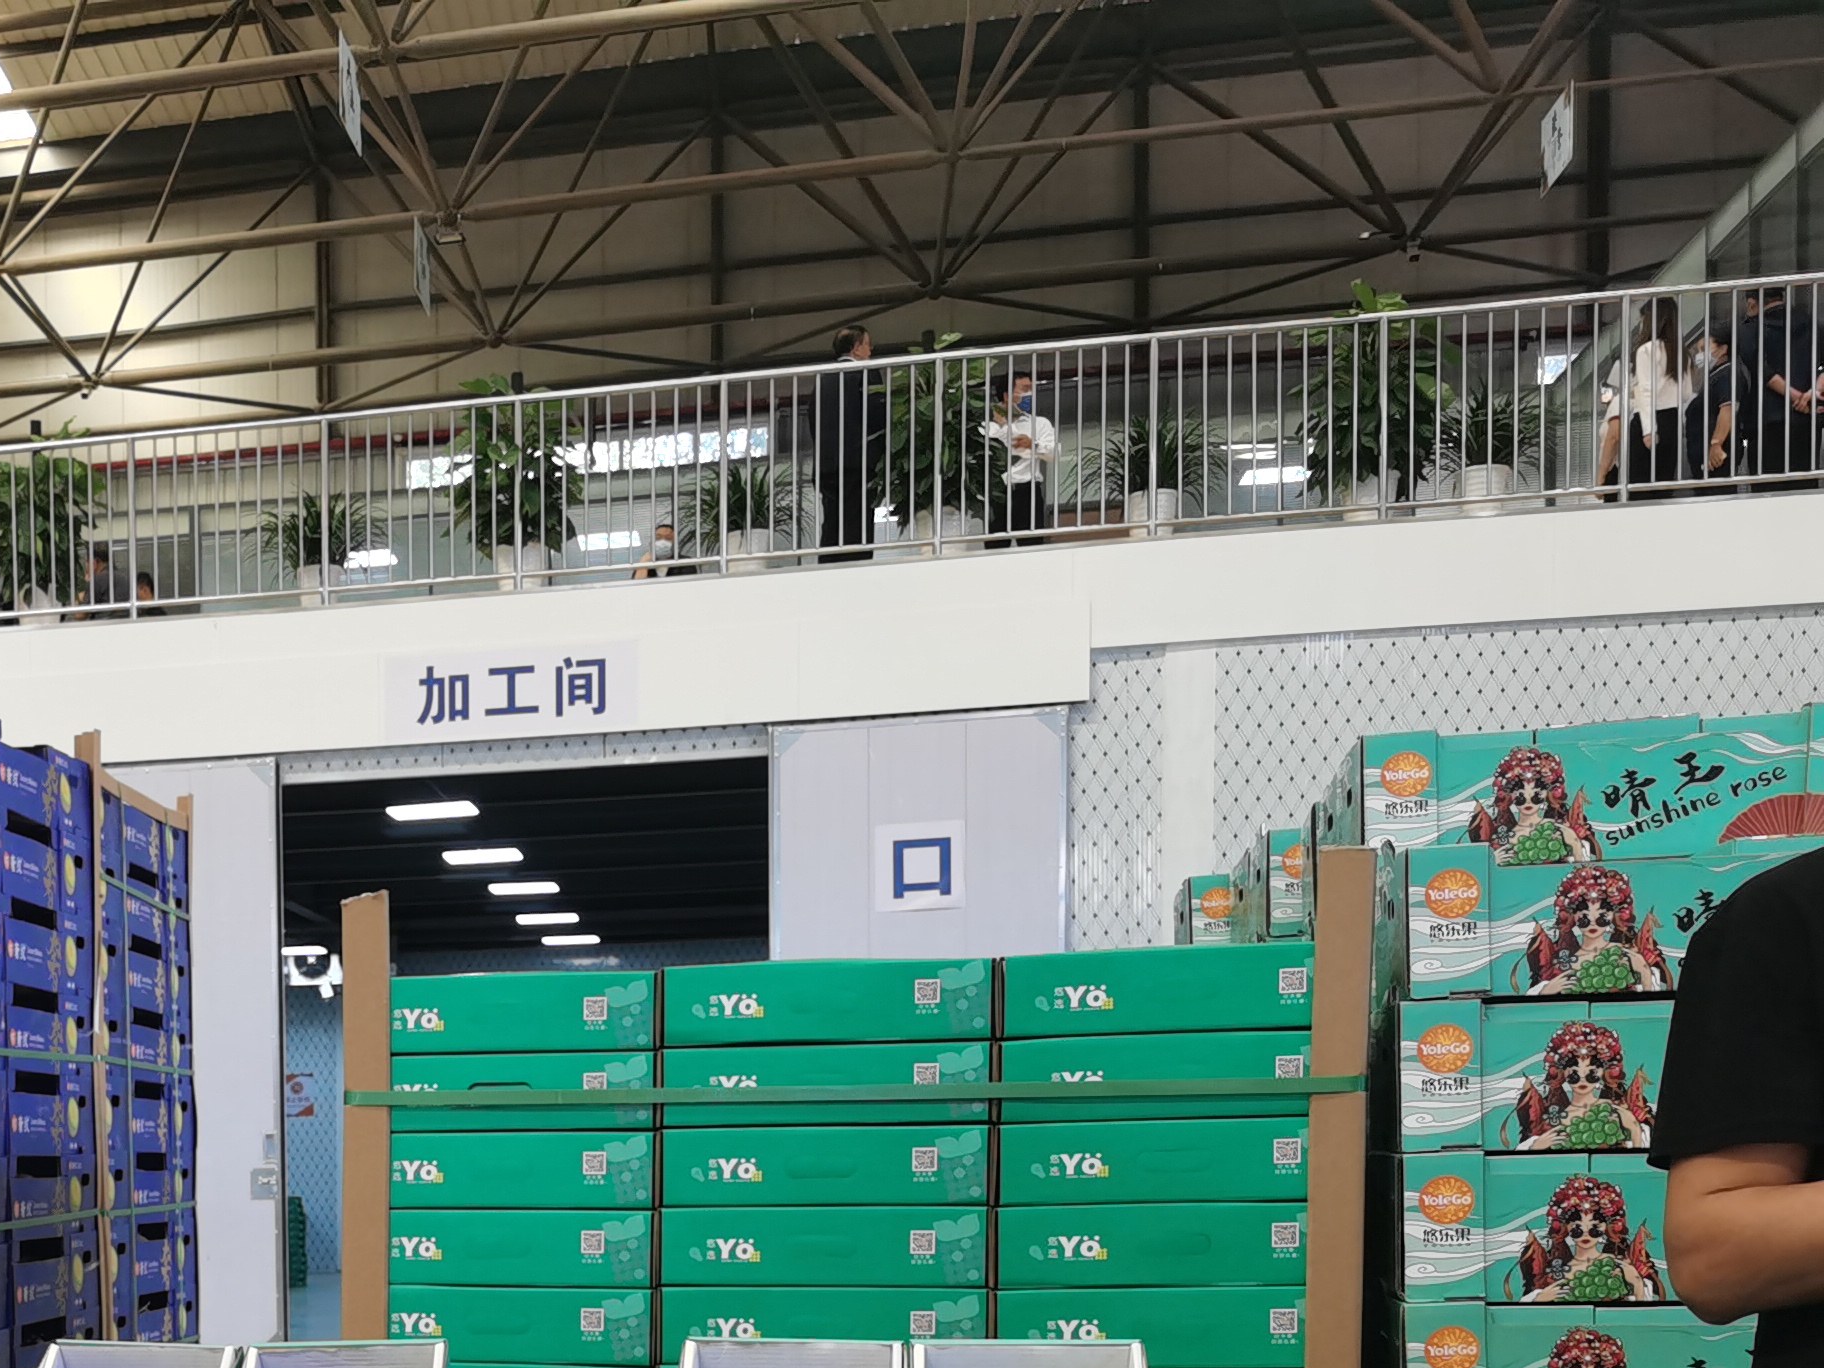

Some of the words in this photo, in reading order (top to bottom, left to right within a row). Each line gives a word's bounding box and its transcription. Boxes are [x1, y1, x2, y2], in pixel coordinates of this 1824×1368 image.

[417, 656, 609, 725] 加工间
[1601, 752, 1725, 817] 晴王
[1605, 789, 1726, 846] sunshine
[1730, 764, 1788, 796] rose
[892, 836, 951, 899] 口
